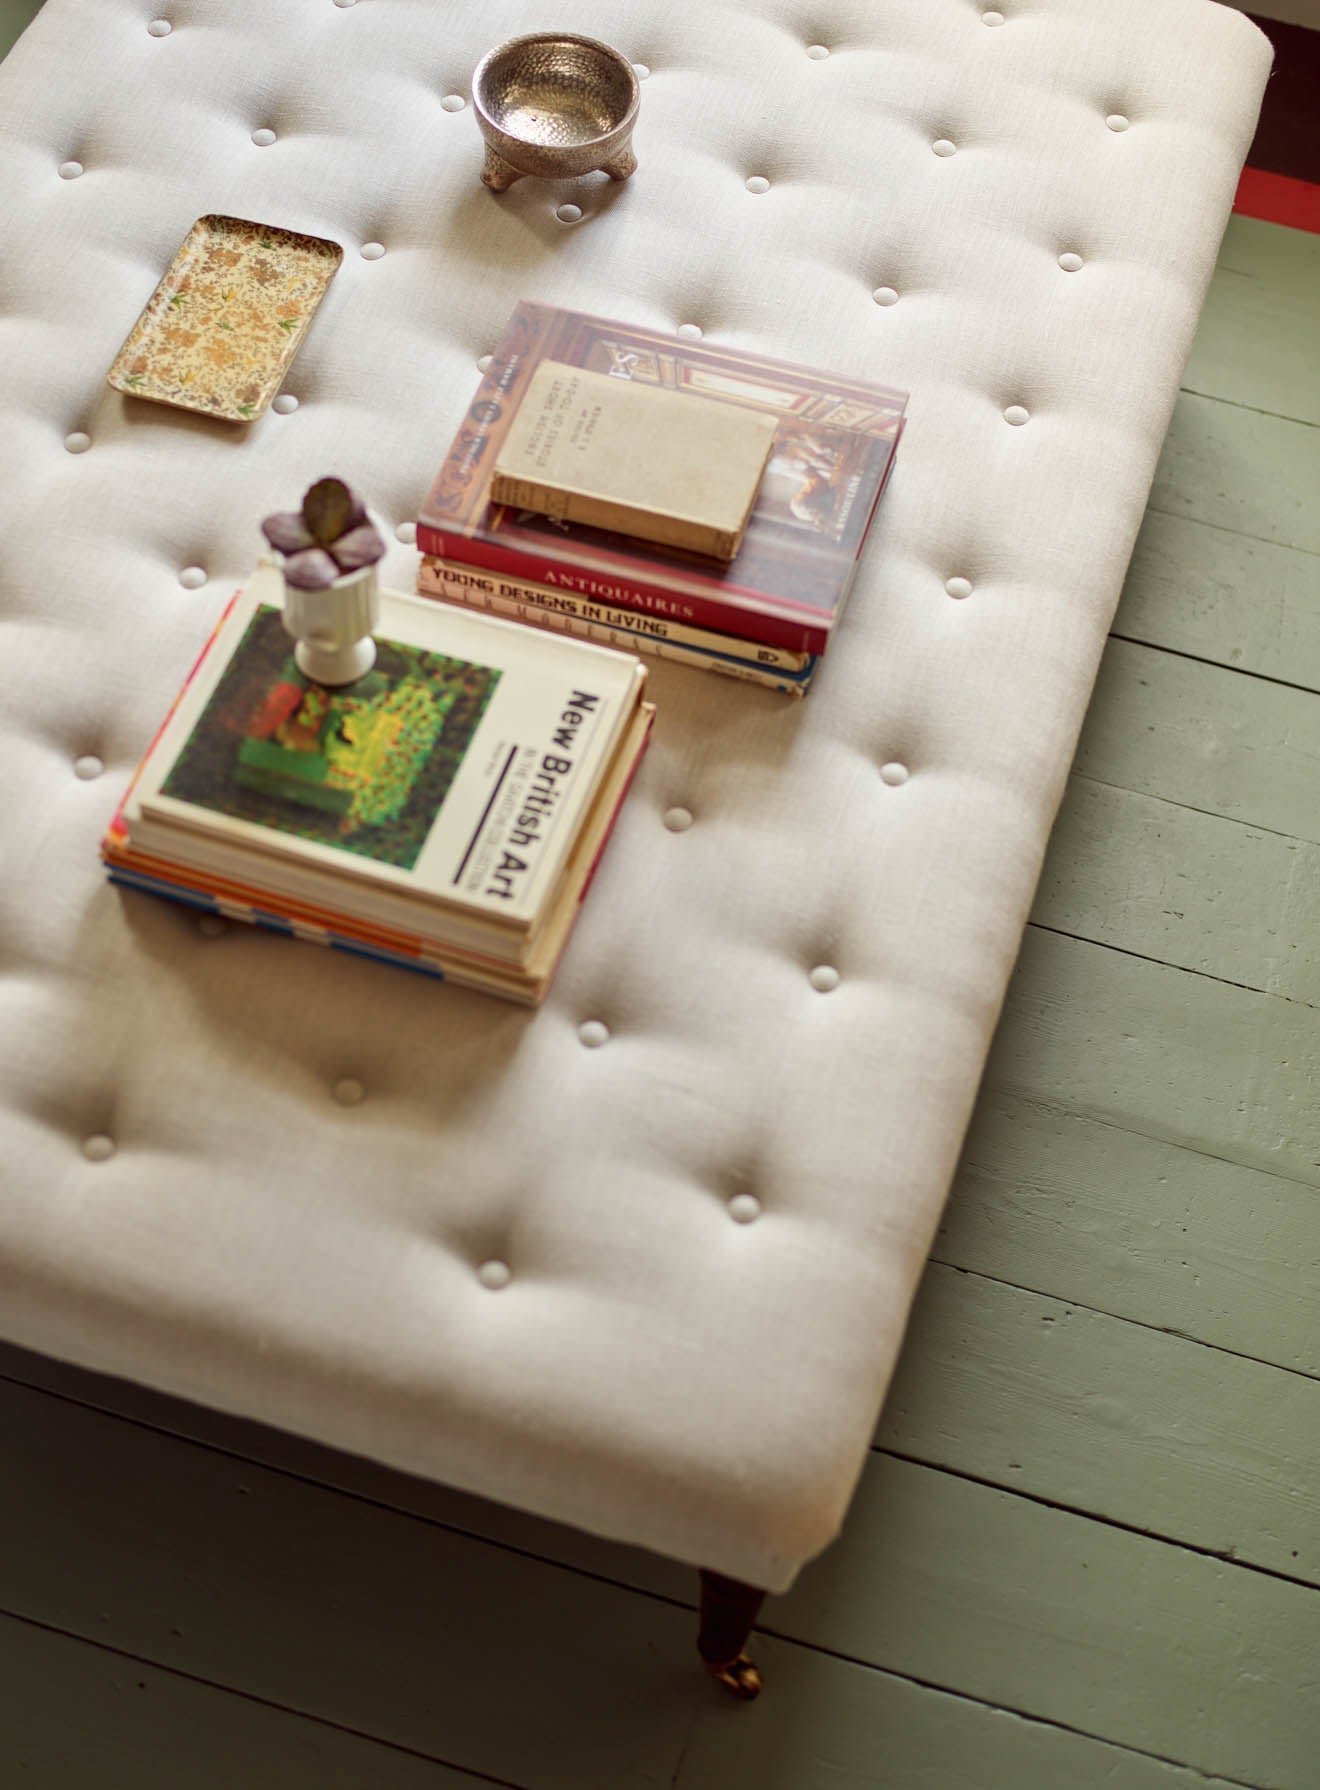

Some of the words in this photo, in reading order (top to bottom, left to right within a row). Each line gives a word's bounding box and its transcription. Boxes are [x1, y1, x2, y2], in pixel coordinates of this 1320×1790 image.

[432, 567, 494, 593] YOUNG
[499, 583, 580, 614] DESIGNS
[582, 602, 602, 620] IN
[606, 610, 669, 637] LIVING
[543, 570, 694, 617] ANTIQUAIRES
[552, 689, 600, 750] New
[509, 754, 573, 847] British
[485, 850, 529, 899] Art
